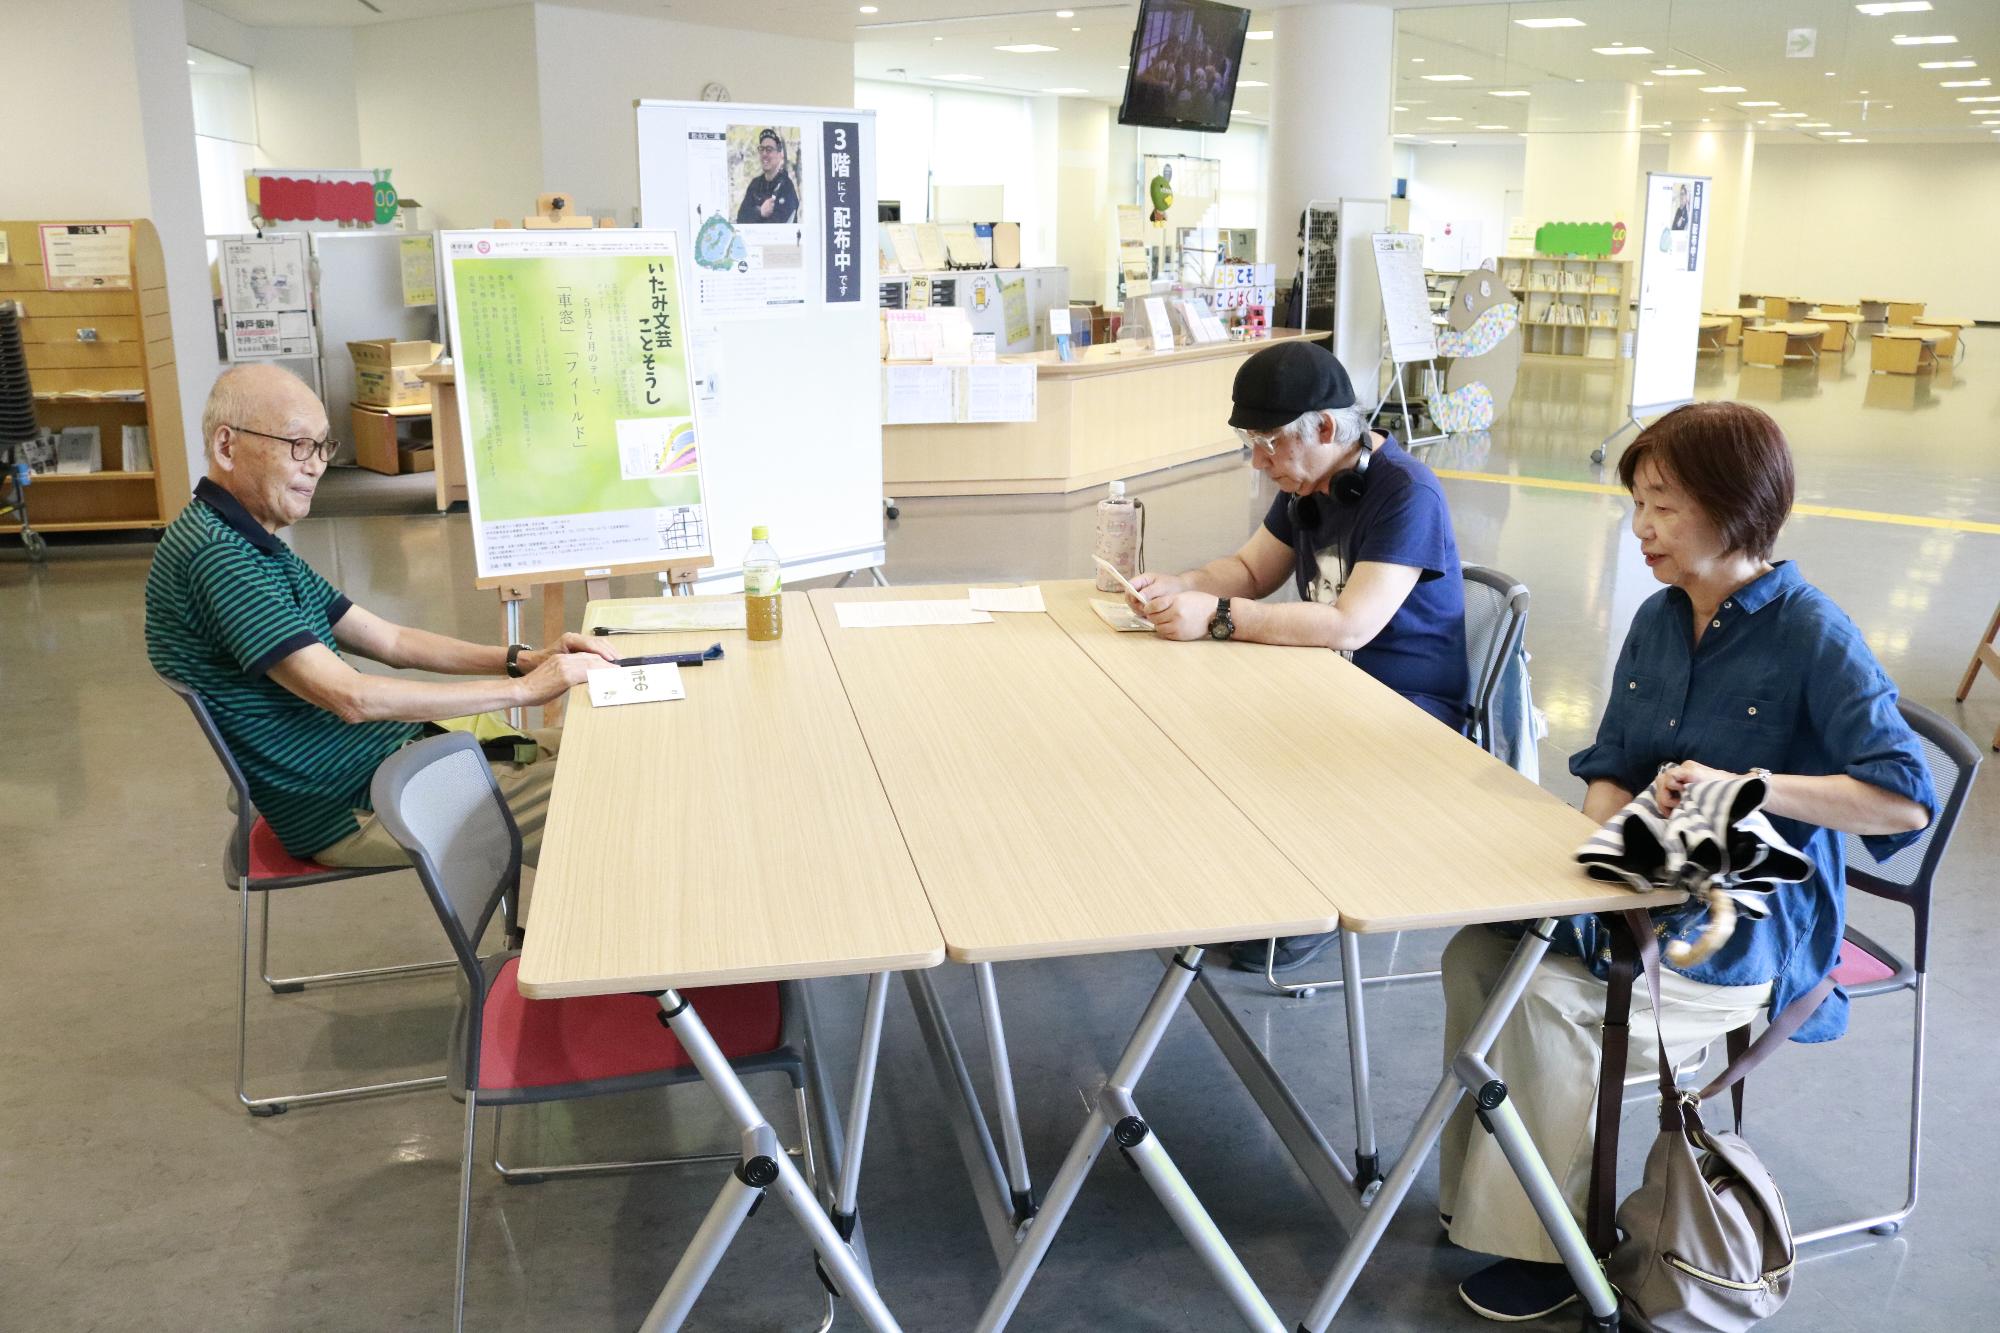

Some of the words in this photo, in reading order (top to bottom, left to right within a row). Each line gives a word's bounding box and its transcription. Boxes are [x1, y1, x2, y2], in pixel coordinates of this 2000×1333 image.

[831, 128, 851, 297] 3階にて配布中です
[556, 285, 576, 333] 「車窓」
[647, 262, 673, 349] いたみ文芸
[1216, 268, 1253, 285] ようこそ
[563, 352, 588, 449] 「フィールド」
[638, 318, 662, 406] ことそうし
